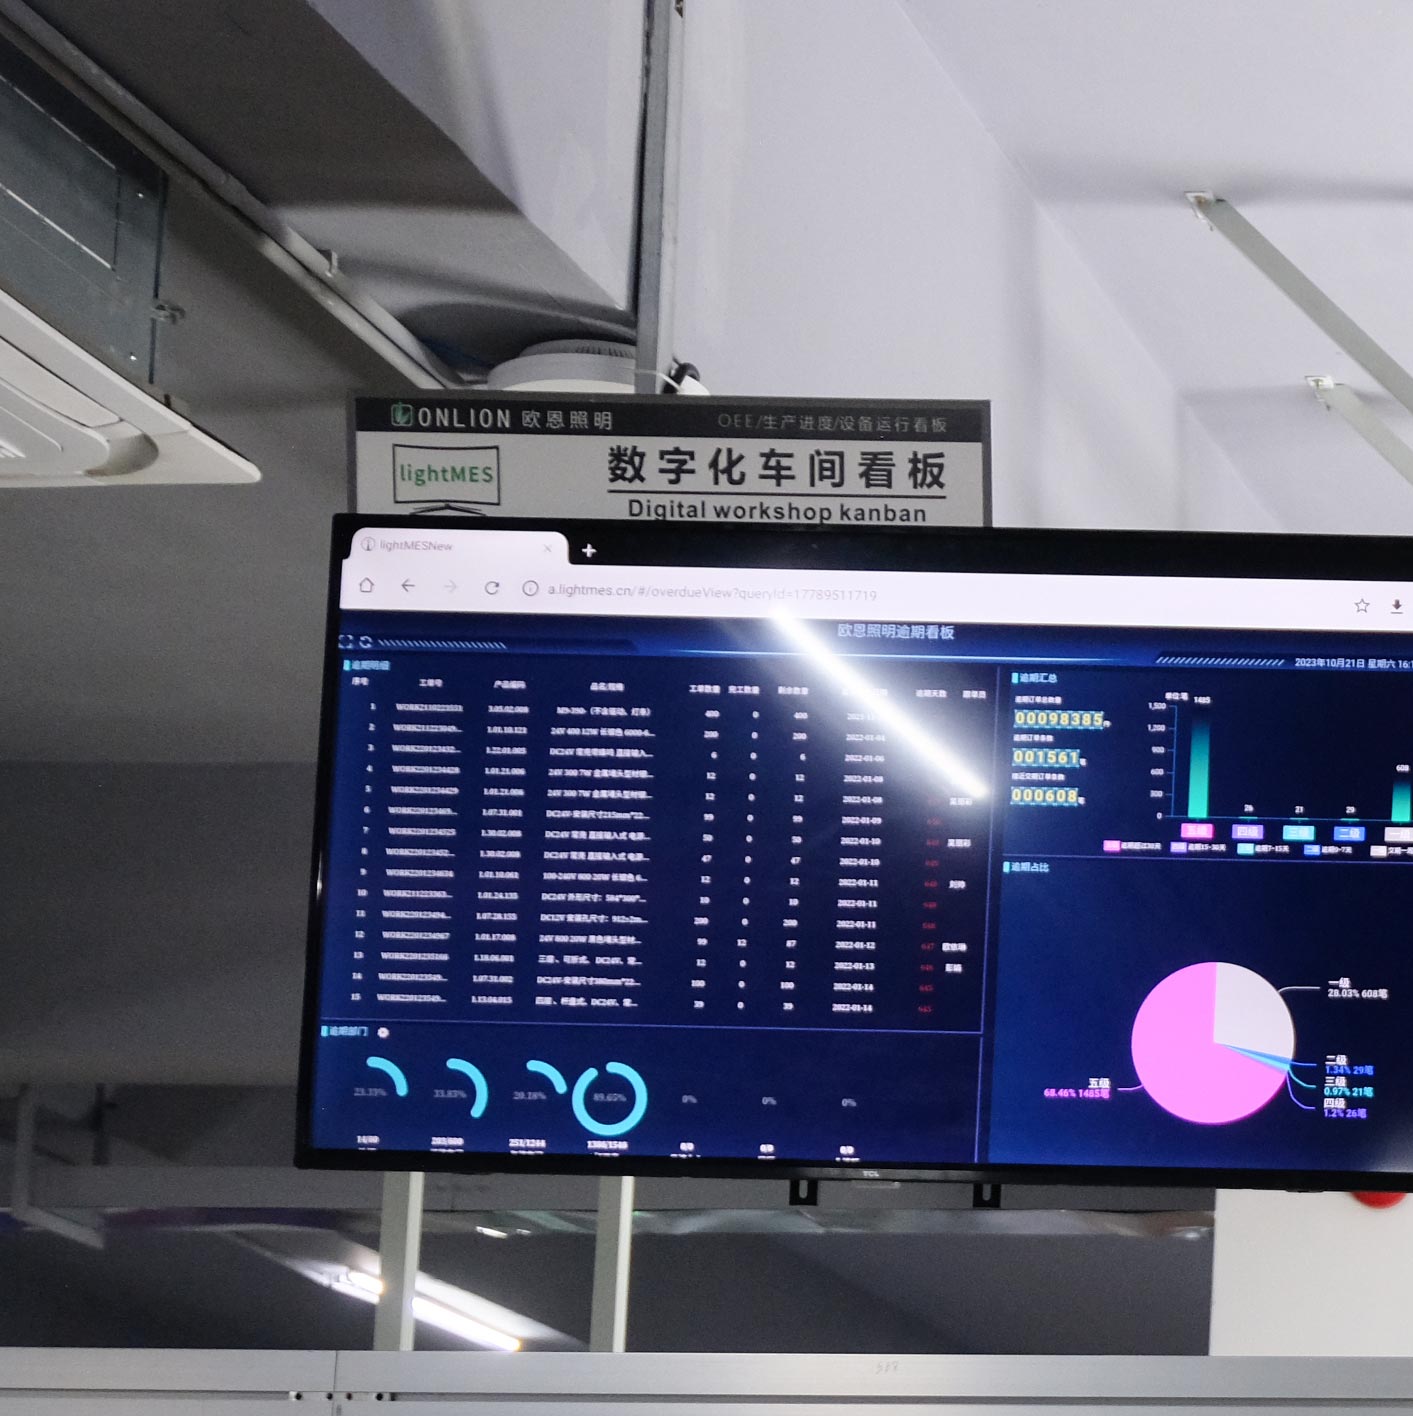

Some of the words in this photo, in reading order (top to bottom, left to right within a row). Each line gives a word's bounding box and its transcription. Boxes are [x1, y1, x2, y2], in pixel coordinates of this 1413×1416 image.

[418, 407, 511, 429] ONLION
[521, 409, 613, 431] 欧恩照明
[718, 413, 947, 434] OEE/生产进度/设备运行看板
[400, 462, 494, 486] lightMES
[607, 445, 947, 490] 数字化车间看板
[628, 499, 705, 522] Digital
[713, 501, 831, 524] workshop
[839, 504, 927, 524] kanban
[379, 540, 453, 552] lightMESNew
[838, 623, 955, 640] 欧恩照明逾期看板
[1295, 657, 1365, 670] 2023年10月21日
[1367, 659, 1396, 670] 星期六
[1020, 673, 1058, 684] 逾期汇总
[1015, 712, 1103, 726] 00098385
[1014, 751, 1077, 764] 001561
[1012, 789, 1077, 802] 000608
[1011, 862, 1049, 872] 逾期占比
[1328, 978, 1350, 988] 一级
[1328, 989, 1359, 998] 28.03%
[1325, 1055, 1347, 1066] 二级
[1088, 1078, 1110, 1089] 五级
[1325, 1076, 1346, 1087] 三级
[1323, 1098, 1345, 1109] 四级
